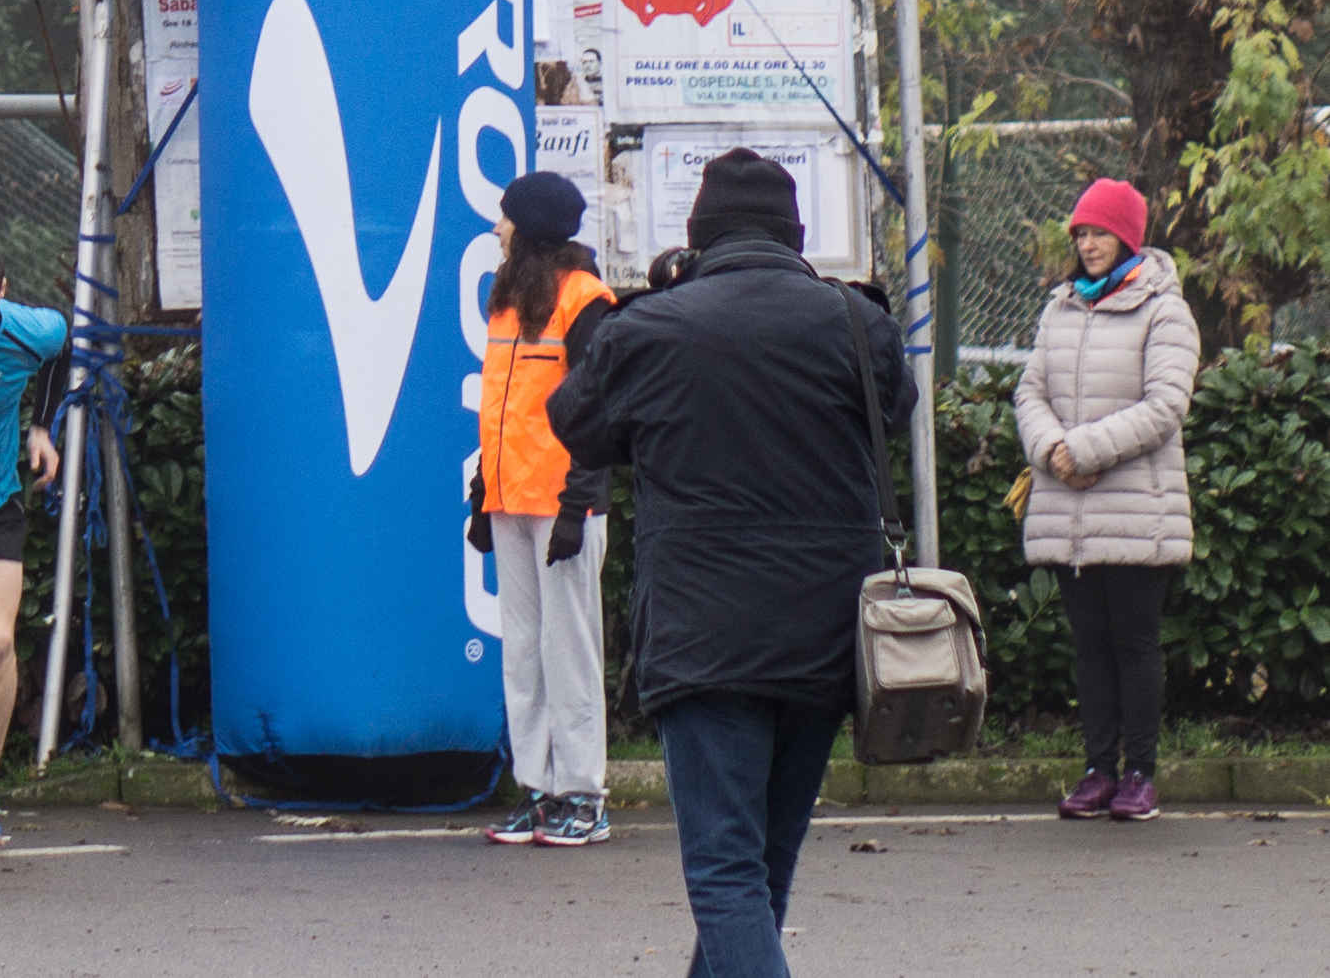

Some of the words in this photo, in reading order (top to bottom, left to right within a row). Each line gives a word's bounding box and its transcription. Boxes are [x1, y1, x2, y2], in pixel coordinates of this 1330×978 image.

[732, 23, 745, 36] IL
[635, 60, 670, 71] DALLE
[674, 60, 700, 71] ORE
[732, 60, 762, 71] ALLE
[764, 60, 789, 71] ORE
[688, 75, 762, 89] OSPEDALE
